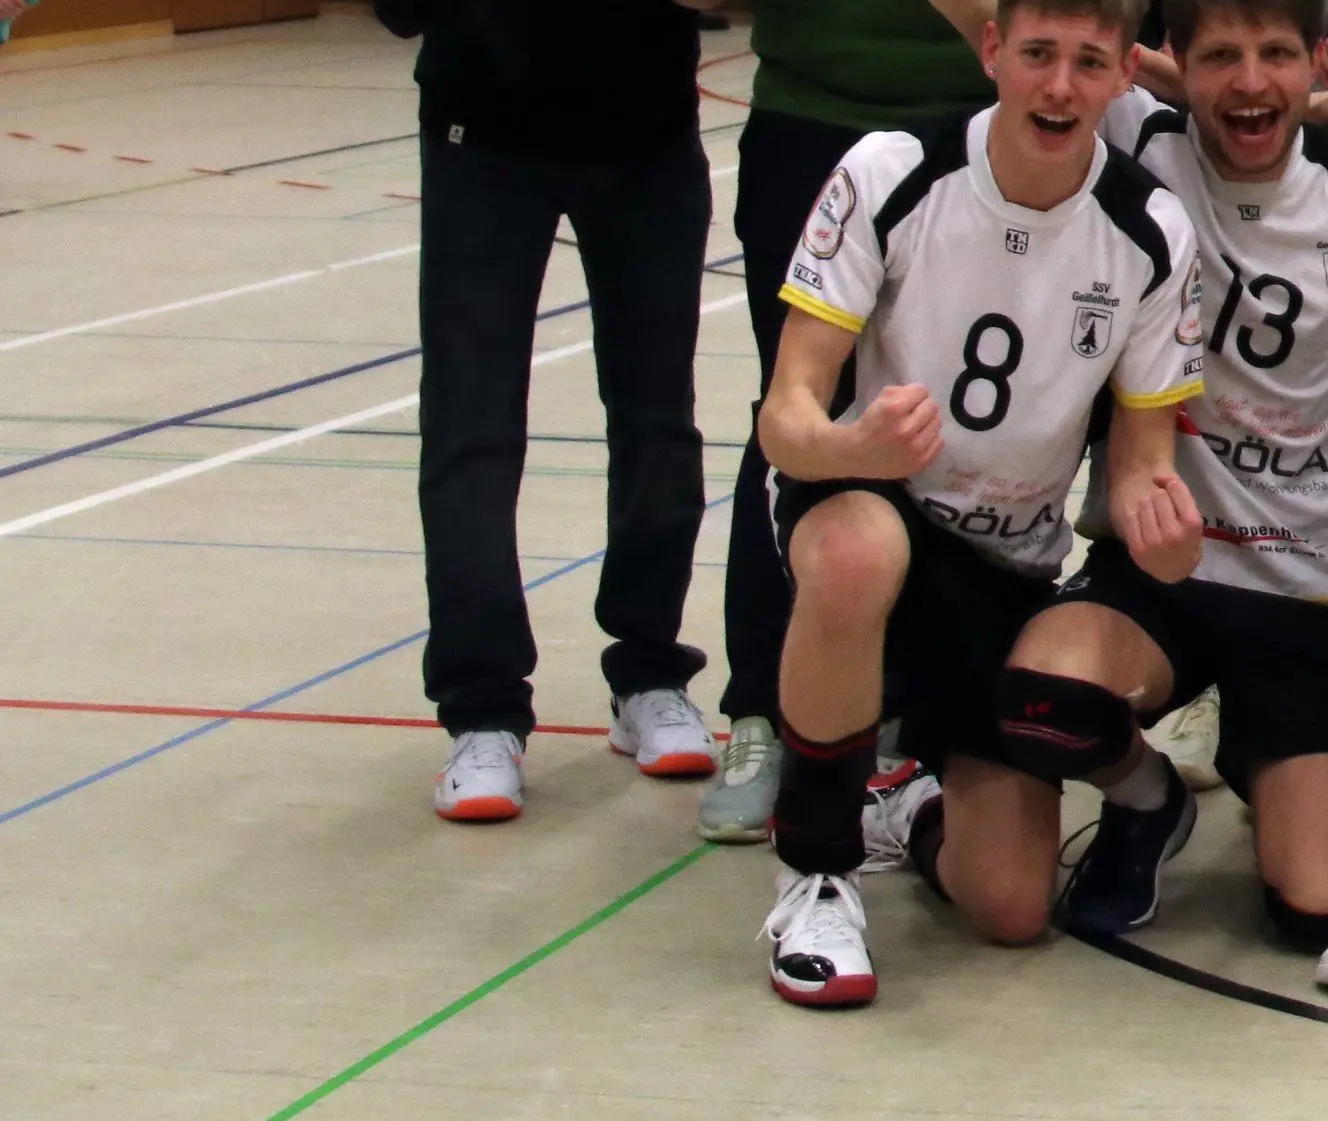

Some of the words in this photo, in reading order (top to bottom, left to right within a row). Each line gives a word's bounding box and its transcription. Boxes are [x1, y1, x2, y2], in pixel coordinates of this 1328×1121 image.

[1092, 282, 1111, 293] SSV
[1209, 254, 1303, 369] 13
[950, 313, 1024, 431] 8
